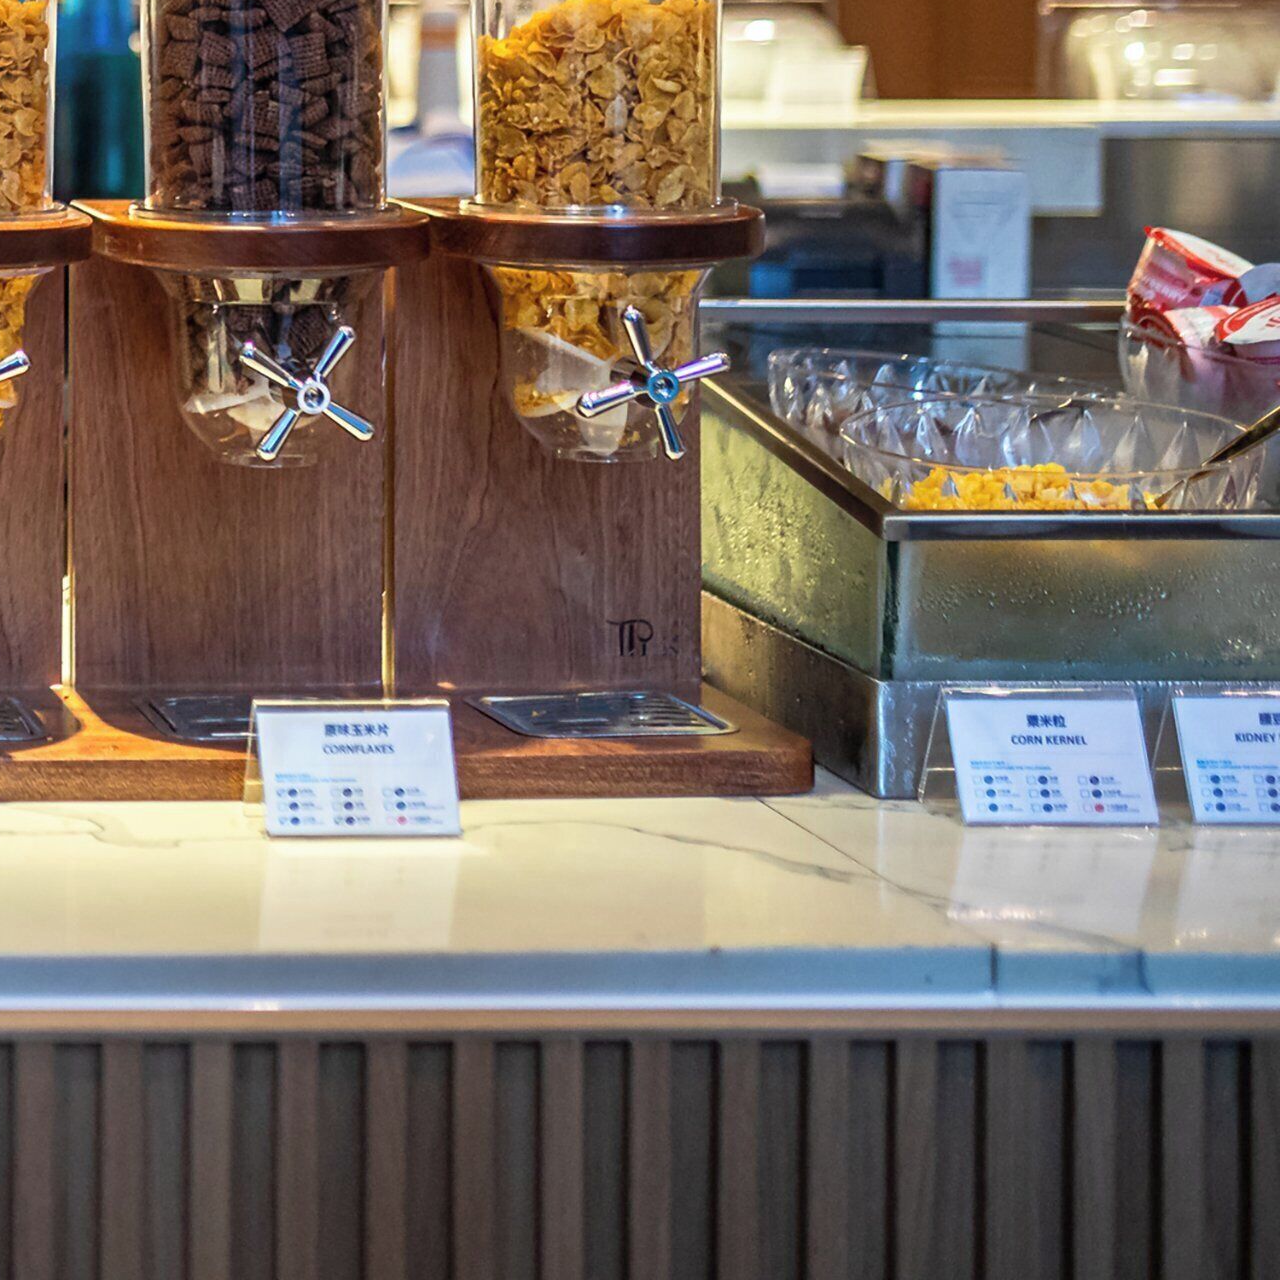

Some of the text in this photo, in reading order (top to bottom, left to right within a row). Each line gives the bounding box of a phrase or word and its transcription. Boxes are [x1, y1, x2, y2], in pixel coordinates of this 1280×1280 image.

[1011, 735, 1088, 746] CORN KERNEL
[1234, 732, 1275, 742] KIDNEY
[322, 743, 395, 755] CORNFLAKES
